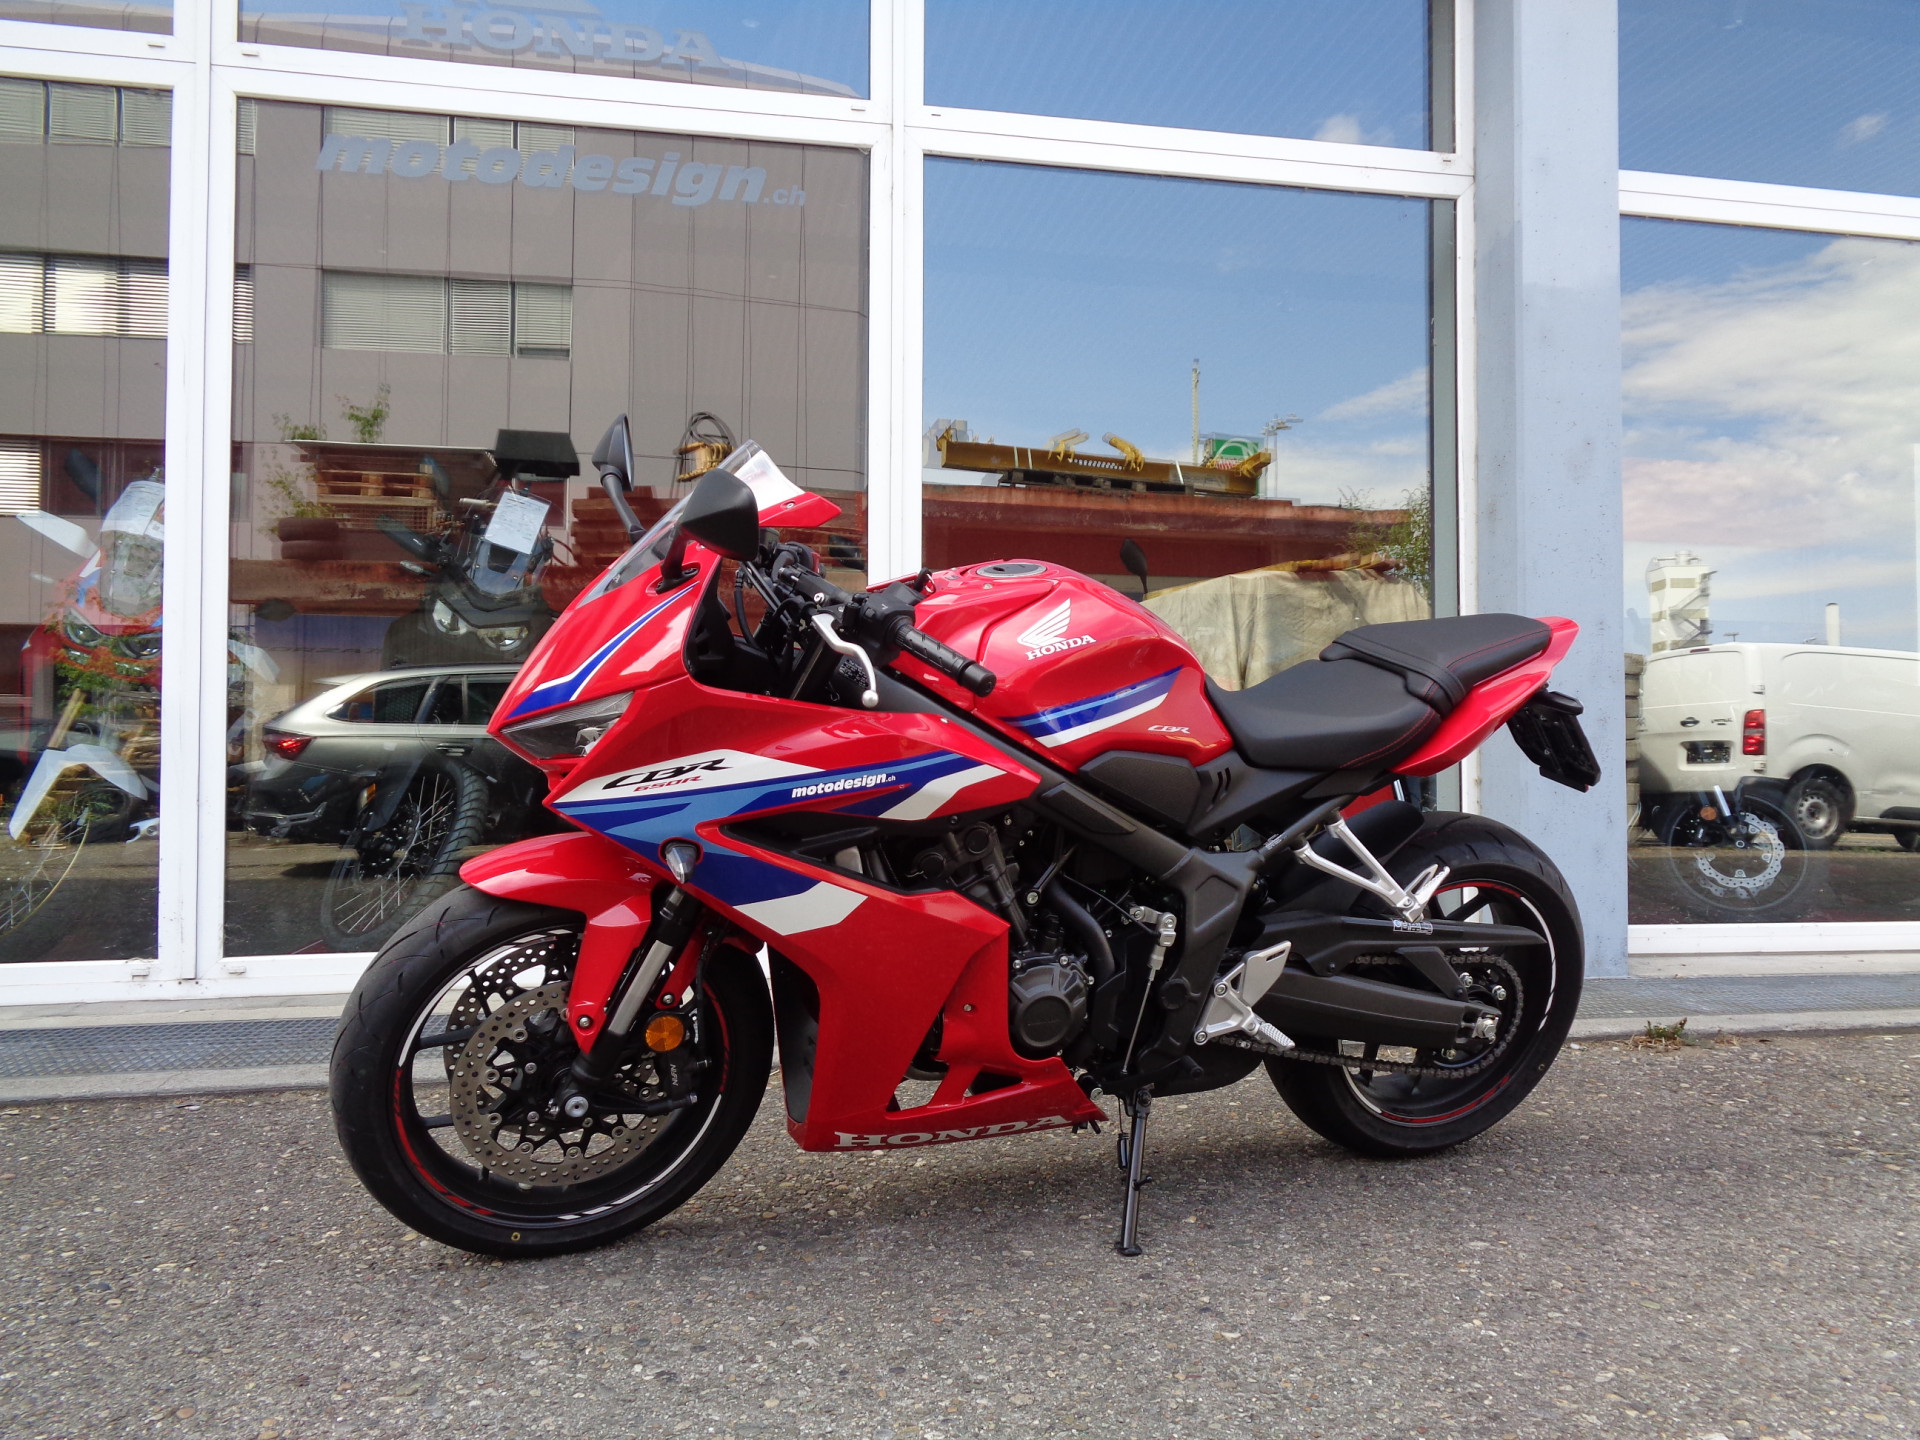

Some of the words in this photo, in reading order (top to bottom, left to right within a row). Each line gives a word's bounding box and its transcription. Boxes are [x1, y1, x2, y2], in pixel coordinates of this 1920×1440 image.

[403, 3, 729, 69] HONDA
[315, 133, 807, 207] motodesign.ch
[1025, 634, 1096, 661] HONDA
[1147, 724, 1191, 734] CBR
[602, 758, 733, 790] CBR
[633, 775, 702, 792] 650R
[791, 773, 896, 798] motodesign.ch
[834, 1114, 1072, 1147] HONDA
